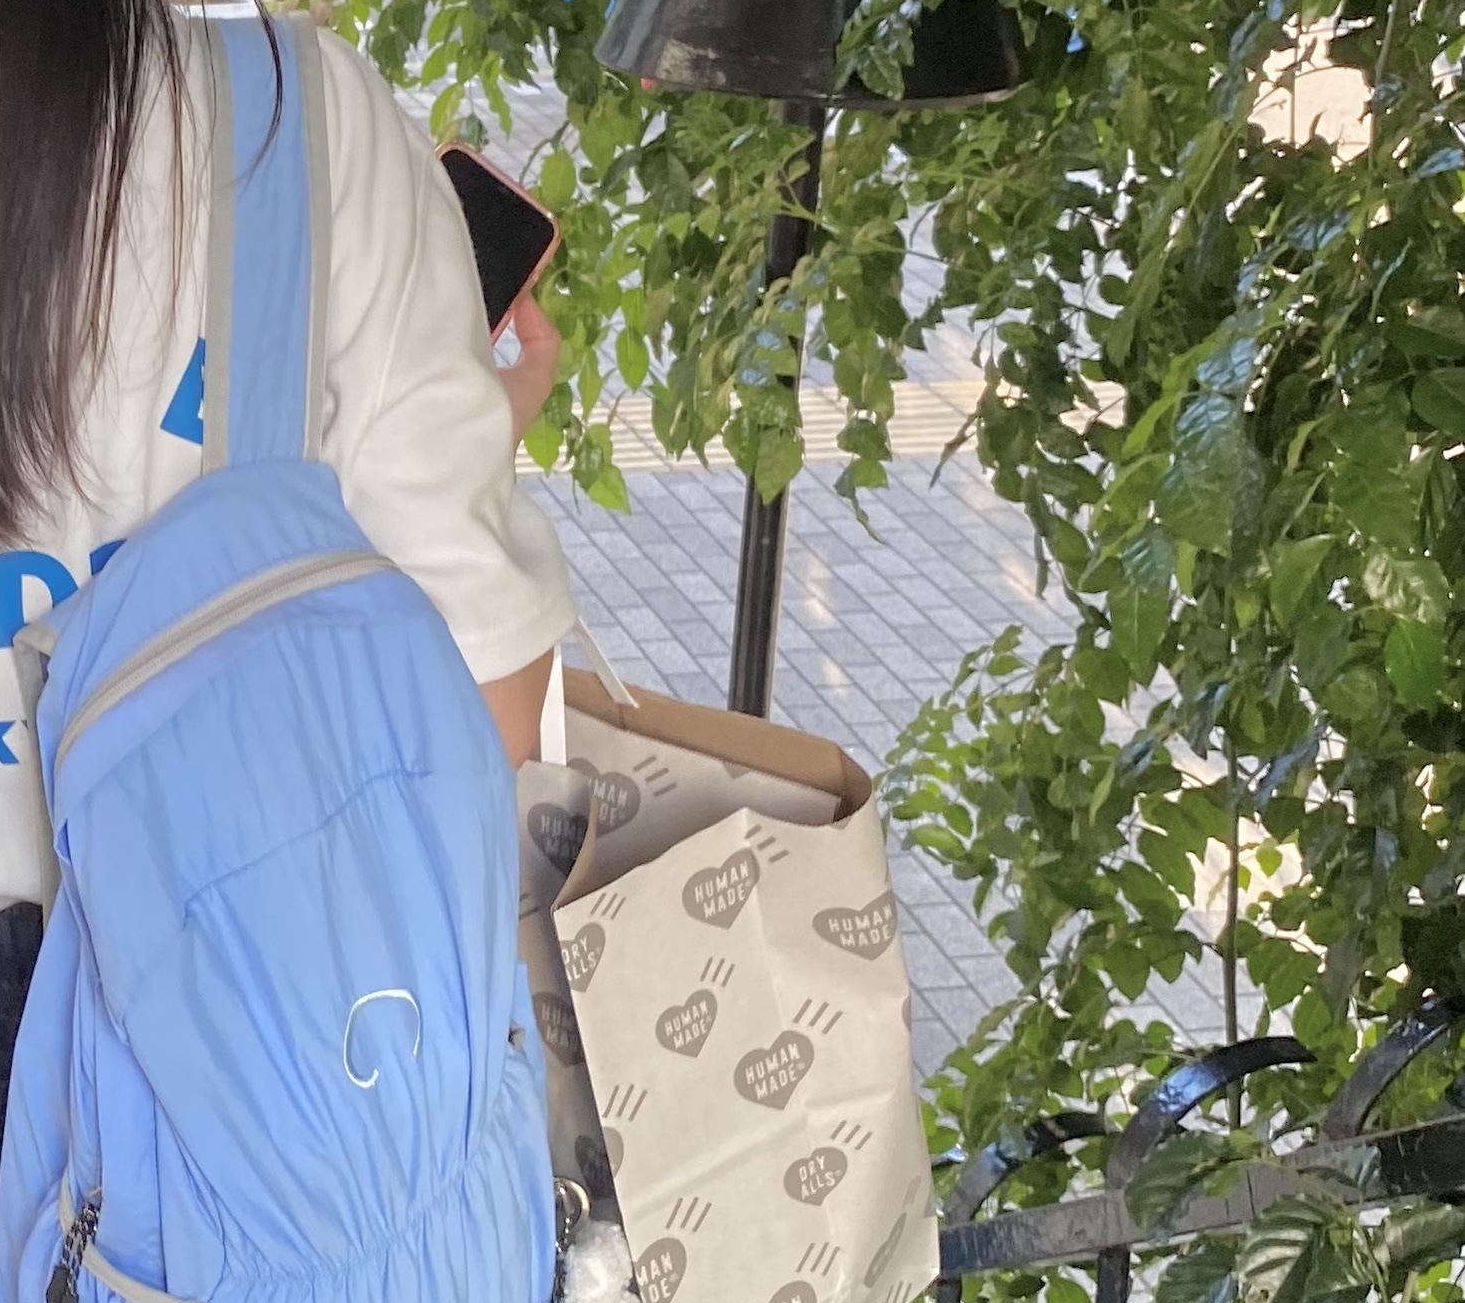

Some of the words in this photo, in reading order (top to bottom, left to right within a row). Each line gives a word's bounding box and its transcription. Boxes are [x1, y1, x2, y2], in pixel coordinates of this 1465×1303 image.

[694, 860, 749, 904] HUMAN
[702, 883, 746, 919] MADE
[840, 924, 892, 947] MADE
[565, 951, 597, 982] LLS
[664, 1000, 708, 1037] HUMAN
[673, 1018, 708, 1051] MADE
[745, 1042, 800, 1085] HUMAN
[755, 1063, 798, 1100] MADE
[799, 1155, 825, 1182] DRY
[801, 1171, 836, 1200] ALLS
[636, 1251, 673, 1286] MAN
